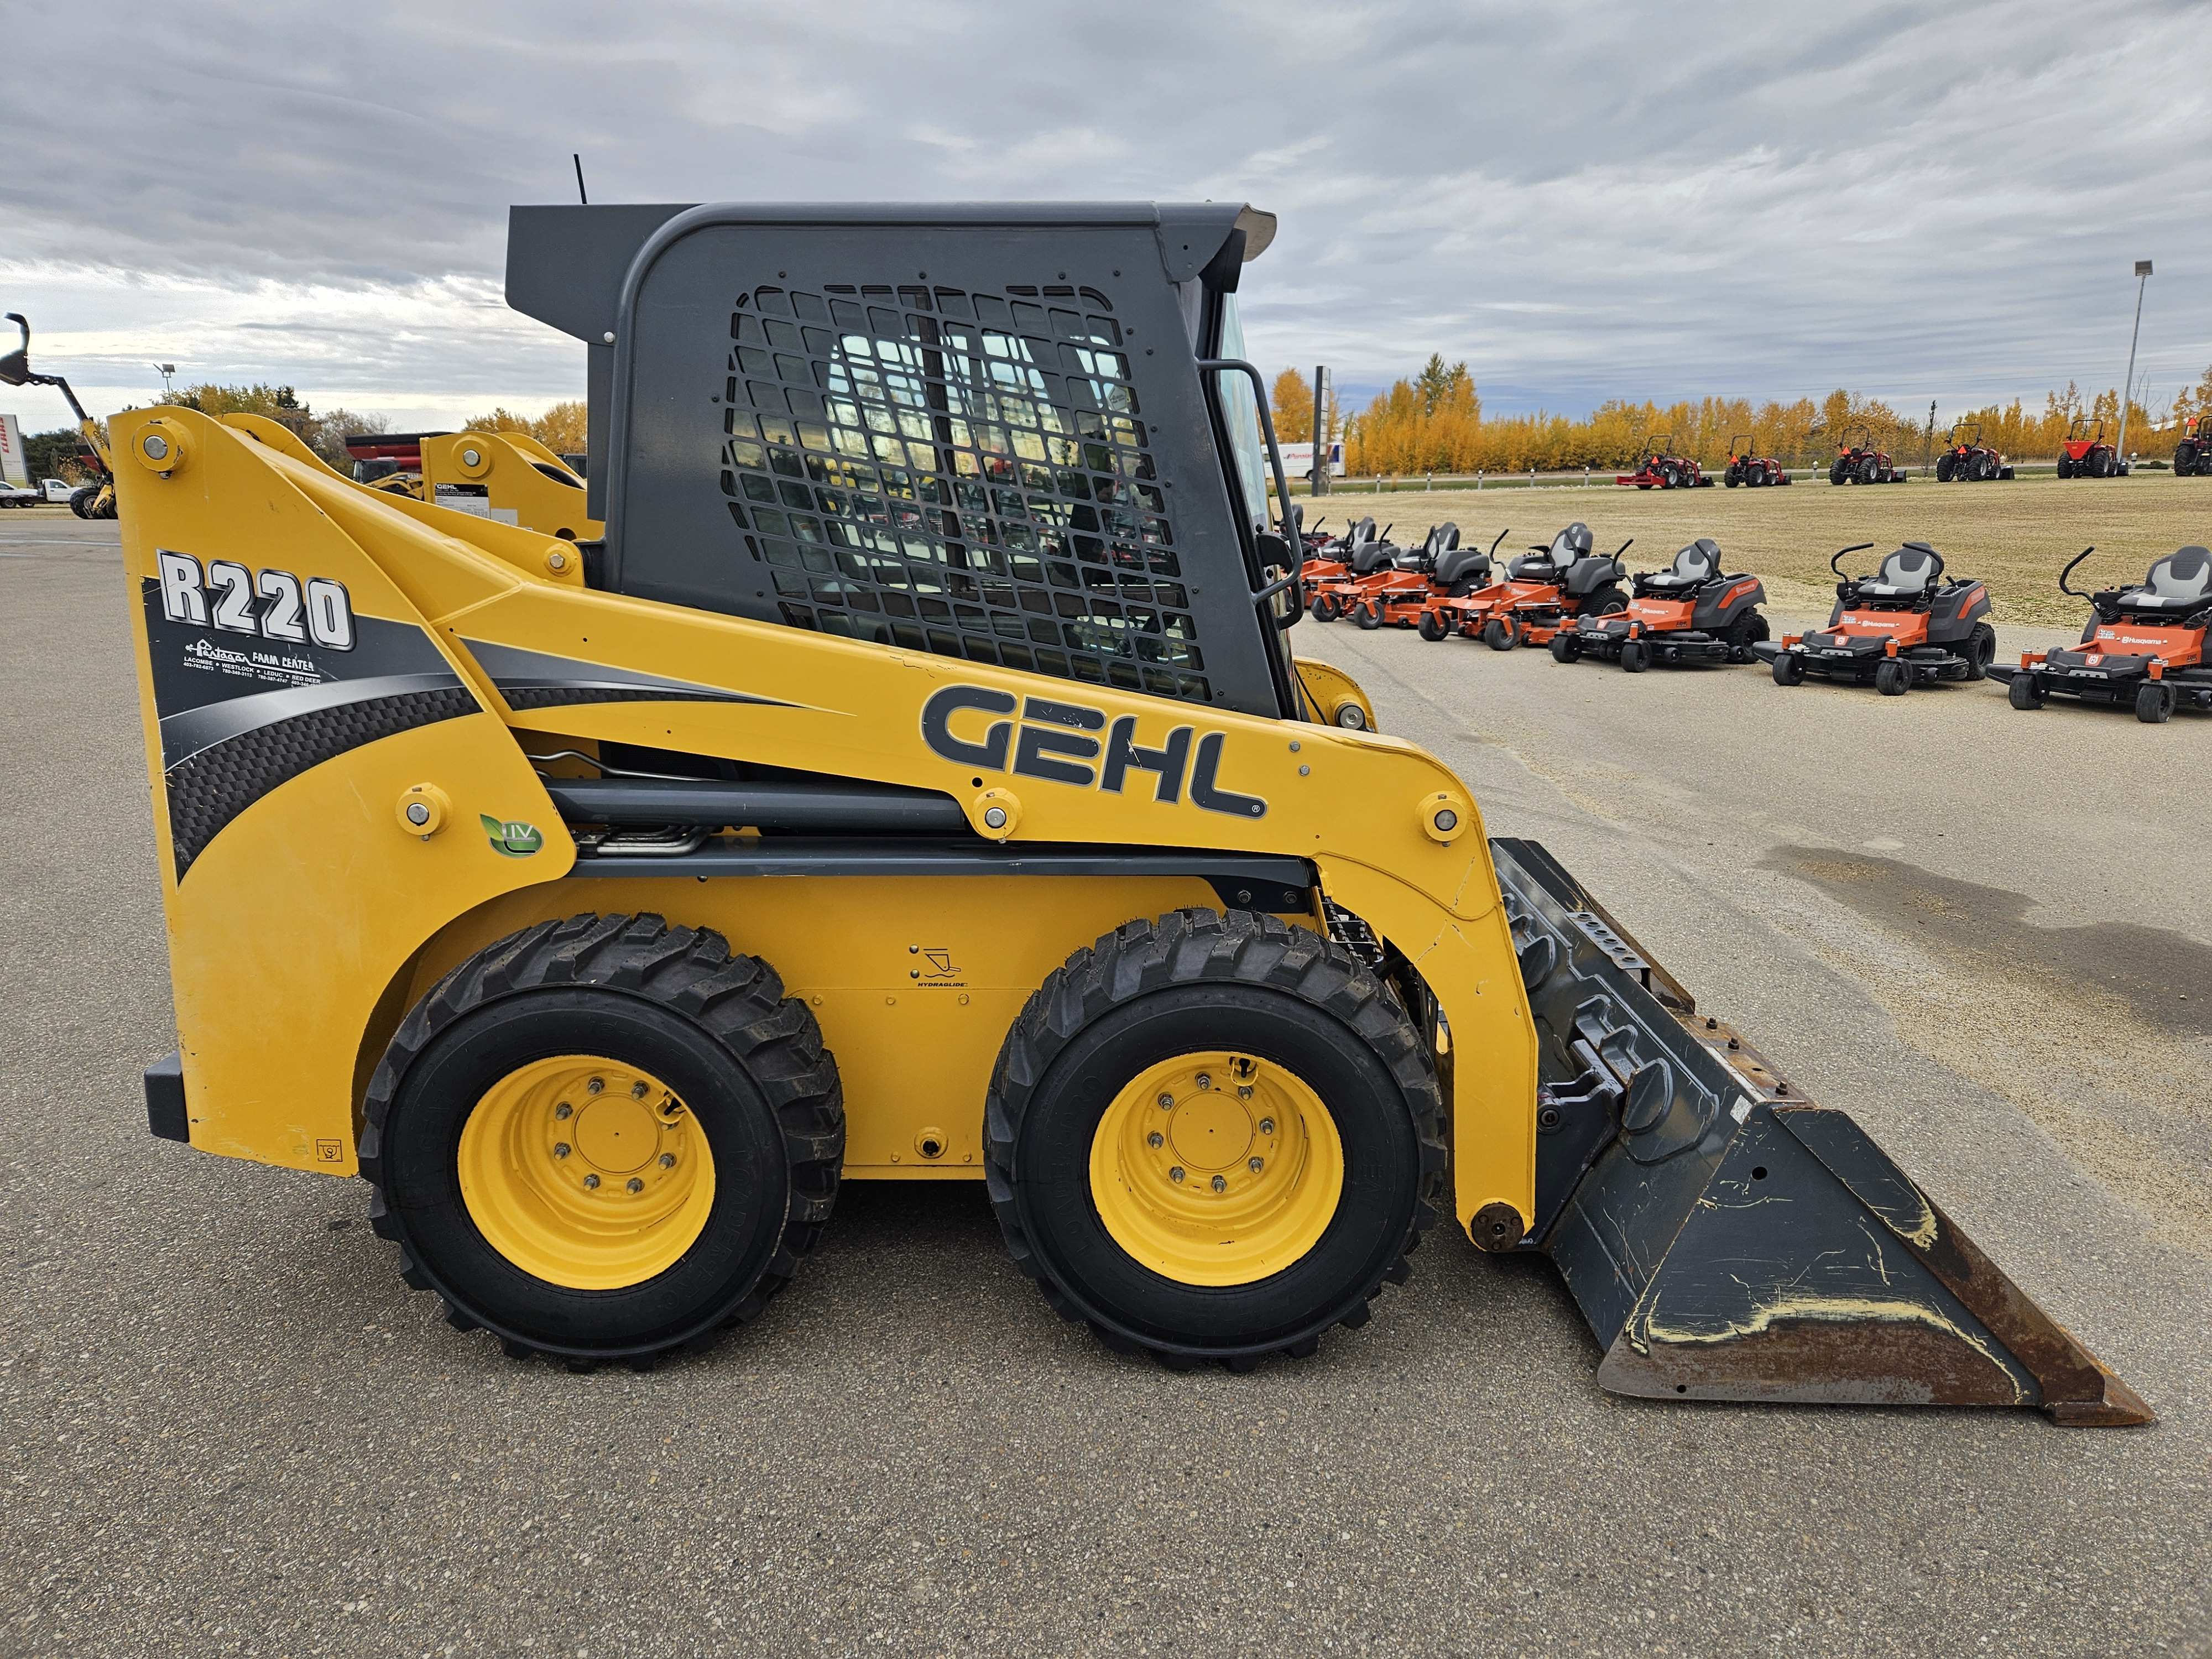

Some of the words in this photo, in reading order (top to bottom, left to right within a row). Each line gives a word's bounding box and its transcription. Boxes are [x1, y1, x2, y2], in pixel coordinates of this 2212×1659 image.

[93, 431, 105, 449] GEHL
[157, 550, 355, 651] R220
[184, 656, 213, 666] LACOMBE
[222, 662, 254, 673] WESTLOCK
[263, 670, 284, 678] LEDUC
[196, 639, 248, 662] Pentagon
[253, 651, 279, 665] FARM
[282, 656, 314, 671] CENTER
[922, 685, 1267, 820] GEHL
[1051, 1076, 1102, 1256] LOADER-PRO
